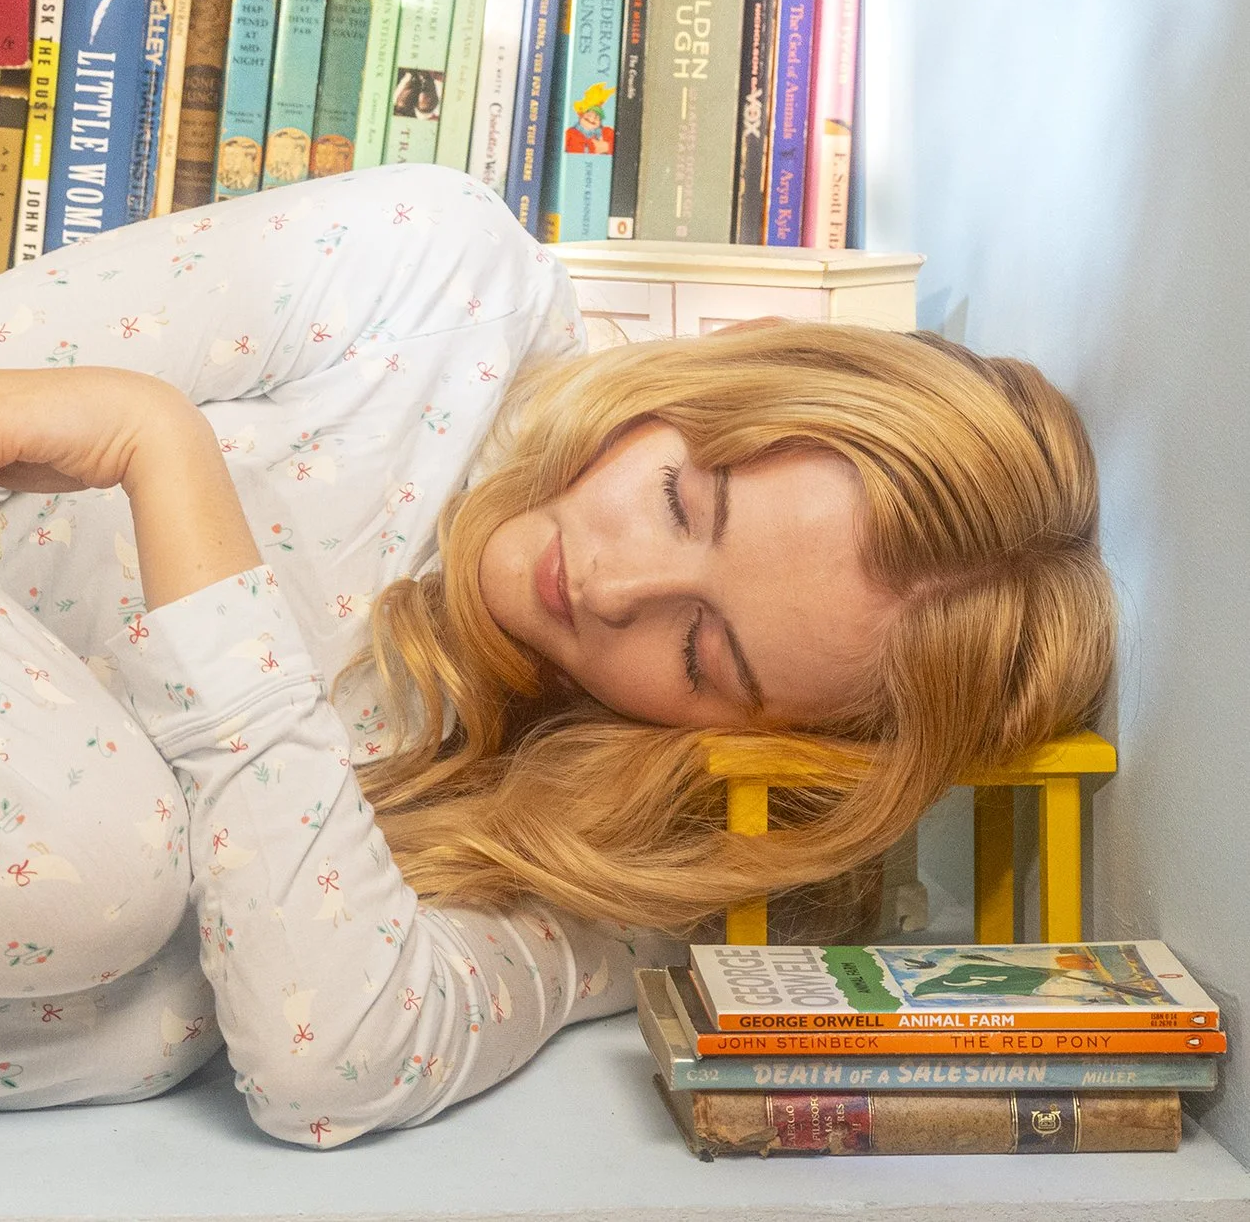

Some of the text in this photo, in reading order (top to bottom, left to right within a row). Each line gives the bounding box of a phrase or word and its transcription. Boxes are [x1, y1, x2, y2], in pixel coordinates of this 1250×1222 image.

[790, 4, 805, 31] The
[38, 37, 54, 65] THE
[786, 33, 803, 63] God
[34, 77, 51, 120] DUST
[781, 83, 800, 139] Animals
[62, 50, 116, 245] LITTLE WOME
[714, 949, 784, 1006] GEORGE
[768, 948, 840, 1007] ORWELL
[739, 1015, 884, 1028] GEORGE ORWELL
[899, 1015, 1014, 1027] ANIMAL FARM
[718, 1036, 879, 1049] JOHN STEINBECK
[953, 1036, 1112, 1048] THE RED PONY
[753, 1060, 1047, 1085] DEATH OF A SALESMAN
[1082, 1071, 1136, 1086] MILLER
